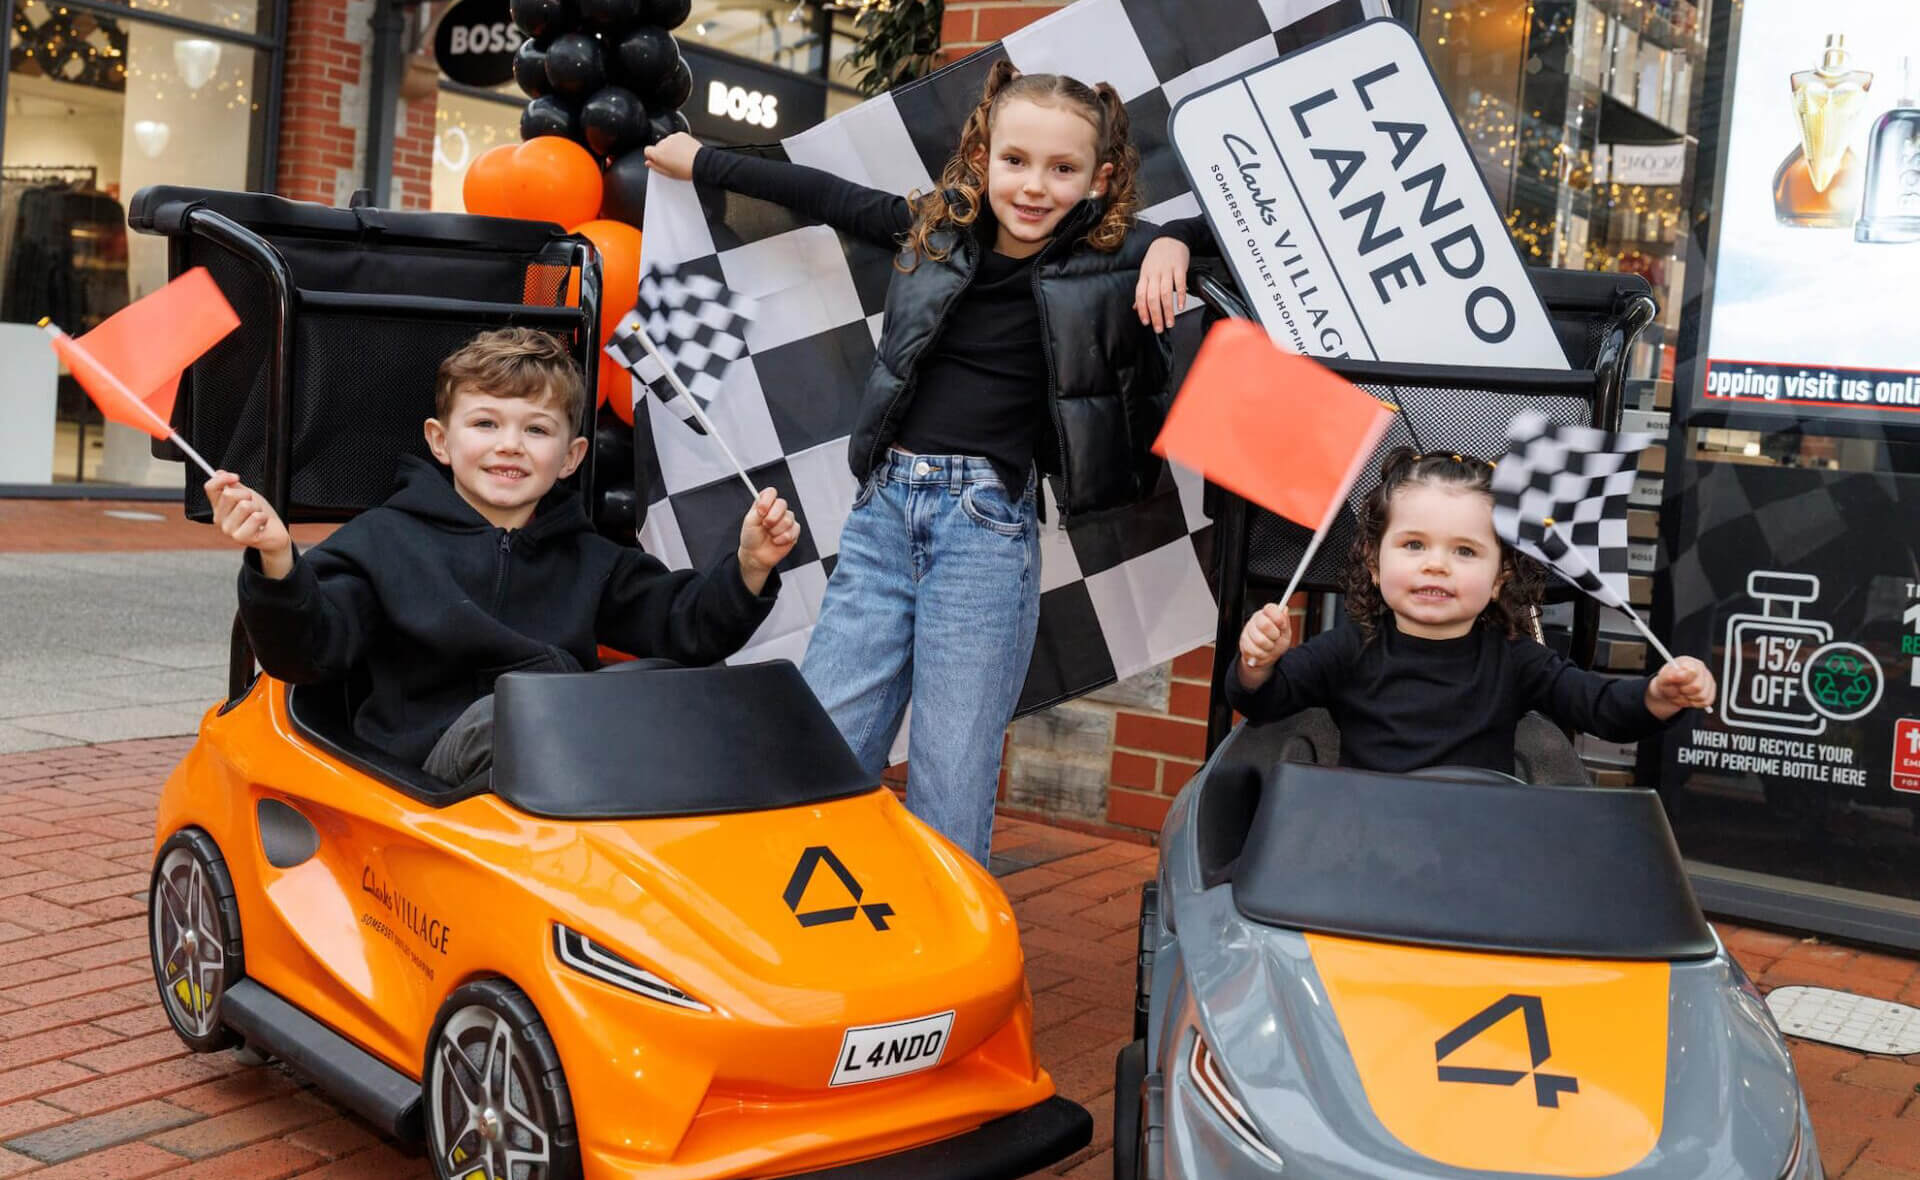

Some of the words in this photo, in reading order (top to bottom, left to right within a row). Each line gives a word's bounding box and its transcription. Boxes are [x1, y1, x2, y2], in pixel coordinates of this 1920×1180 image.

[450, 22, 521, 55] BOSS
[708, 80, 778, 129] BOSS
[1223, 134, 1278, 226] Clarks
[1289, 88, 1427, 304] LANE
[1352, 62, 1516, 344] LANDO
[1210, 164, 1249, 233] SOMERSET
[1247, 238, 1276, 288] OUTLET
[1784, 371, 1839, 399] visit
[1841, 379, 1871, 401] us
[1755, 635, 1801, 673] 15%
[1751, 674, 1800, 707] OFF
[1678, 747, 1719, 768] EMPTY
[1721, 752, 1780, 776] PERFUME
[1782, 761, 1830, 782] BOTTLE
[1832, 767, 1867, 787] HERE
[1692, 729, 1728, 748] WHEN
[1731, 734, 1756, 752] YOU
[1759, 738, 1816, 760] RECYCLE
[1818, 745, 1854, 764] YOUR
[362, 865, 393, 911] Clarks
[393, 890, 451, 955] VILLAGE
[782, 845, 896, 932] 4
[360, 913, 395, 940] SOMERSET
[843, 1030, 943, 1072] L4NDO
[1435, 993, 1579, 1109] 4
